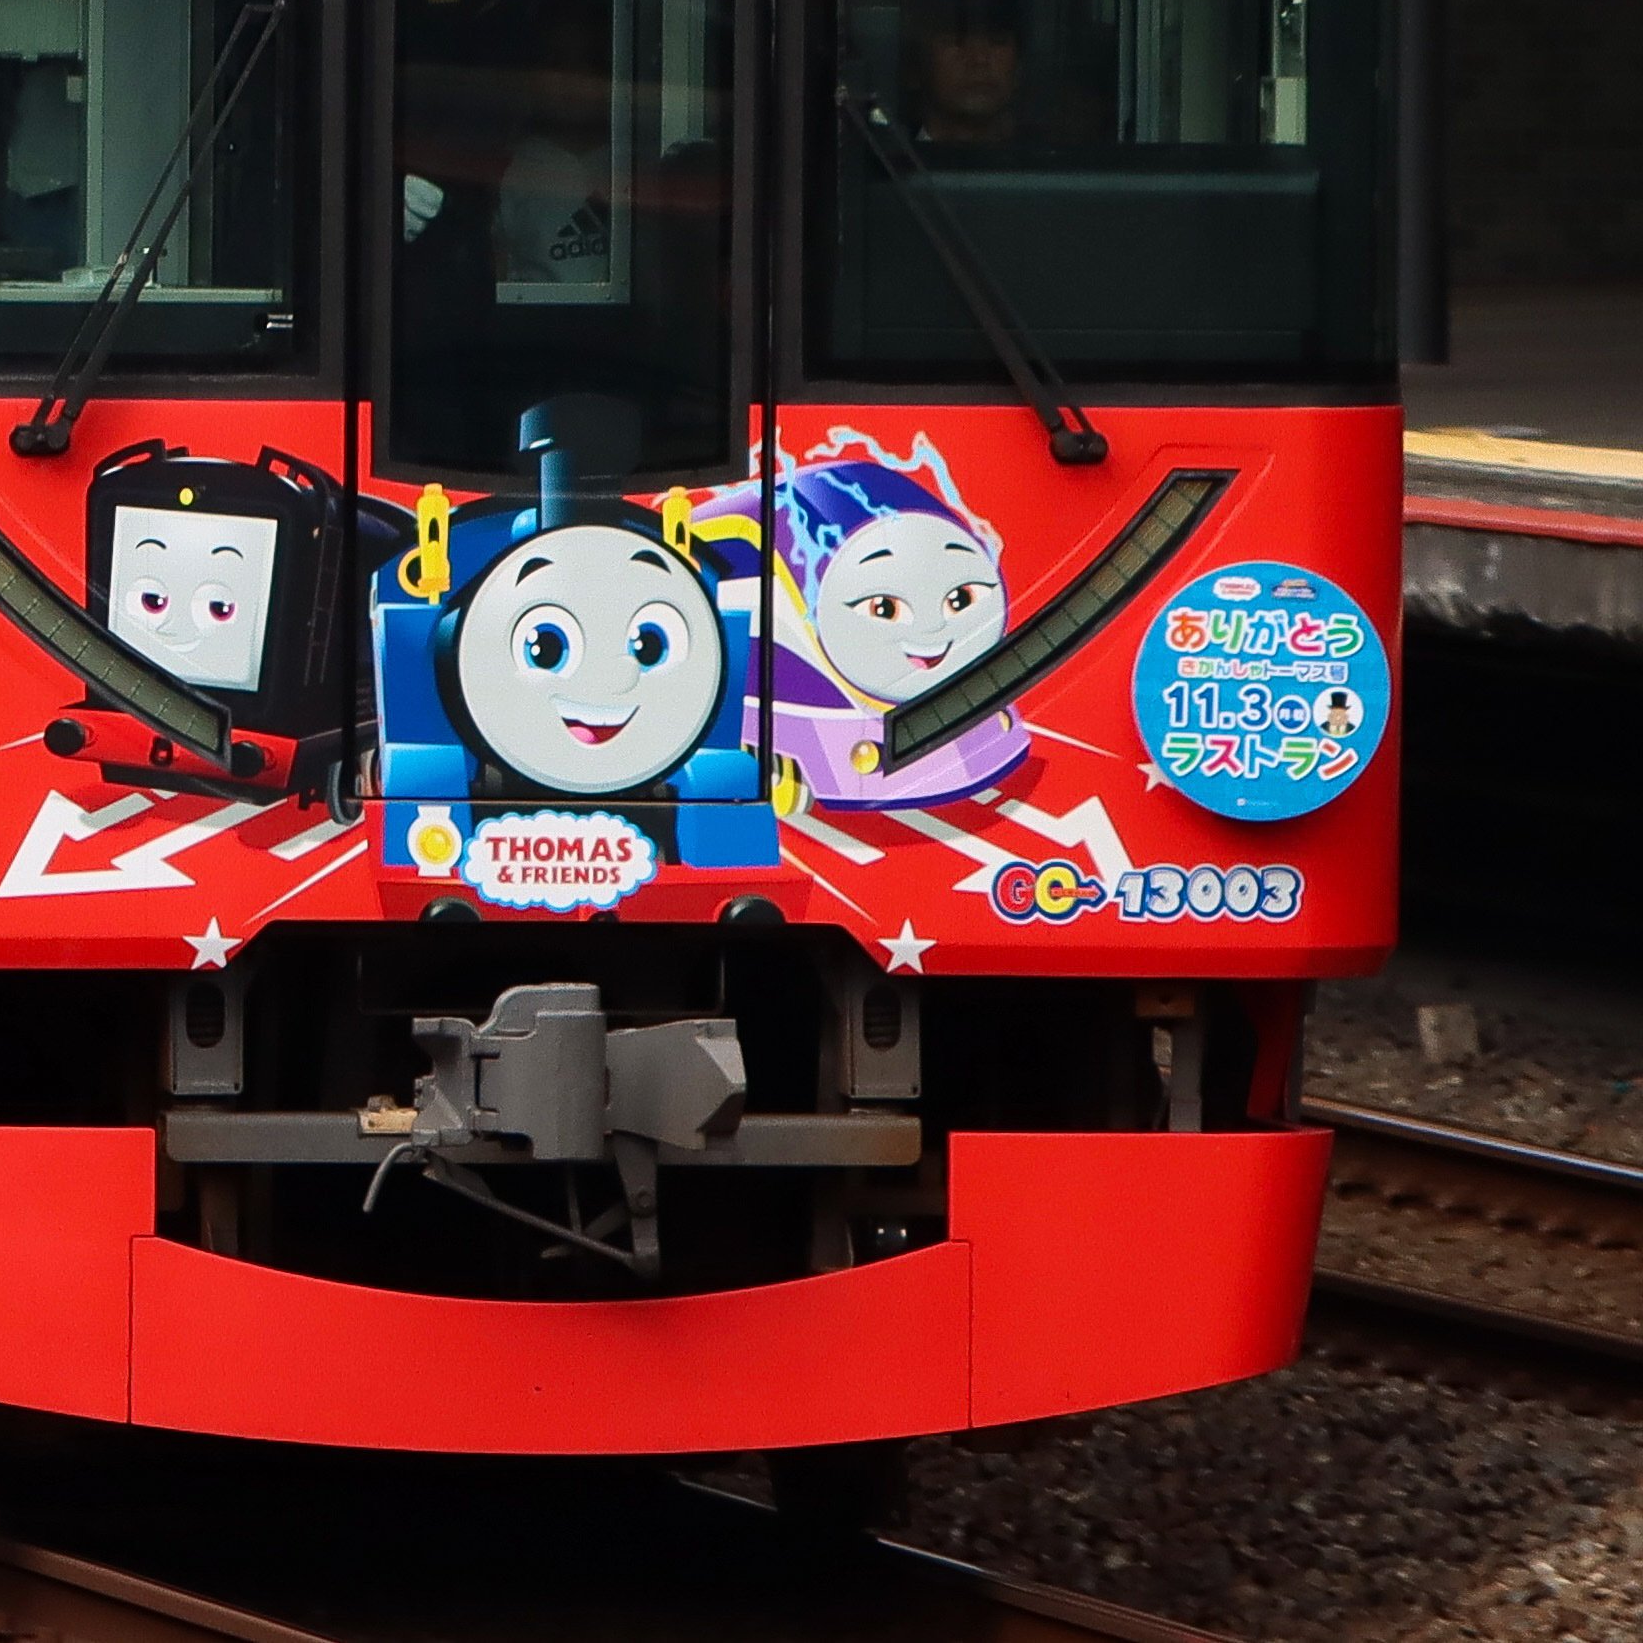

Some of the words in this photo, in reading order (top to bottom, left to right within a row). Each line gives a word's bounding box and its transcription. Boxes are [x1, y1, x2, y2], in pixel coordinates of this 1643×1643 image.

[1168, 609, 1362, 656] ありがとう
[1166, 684, 1270, 729] 11.3
[1165, 734, 1356, 778] ラストラン
[485, 837, 633, 862] THOMAS
[497, 865, 514, 884] &
[521, 866, 621, 884] FRIENDS
[993, 862, 1080, 918] GO
[1118, 864, 1303, 919] 13003
